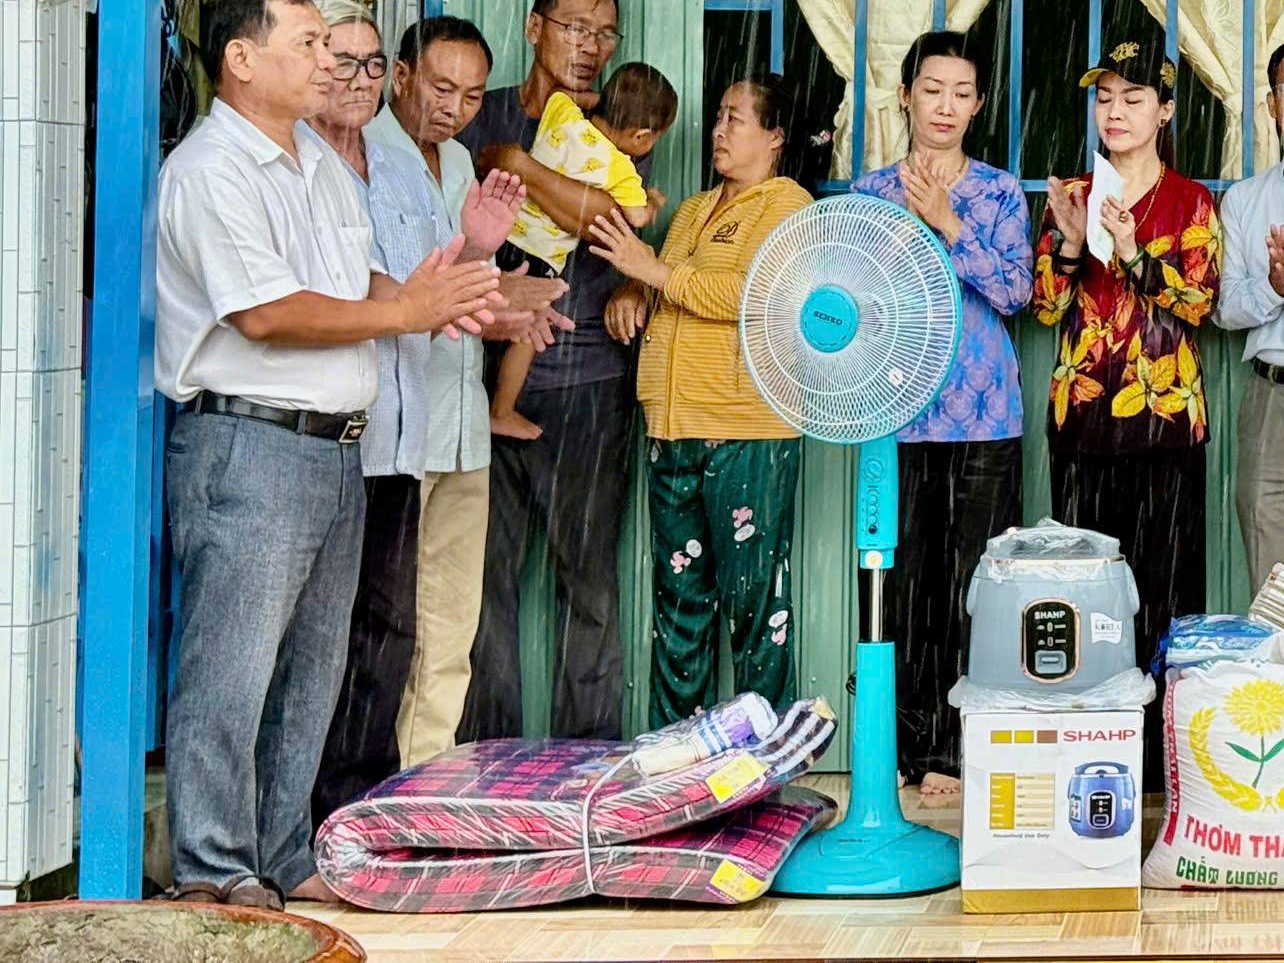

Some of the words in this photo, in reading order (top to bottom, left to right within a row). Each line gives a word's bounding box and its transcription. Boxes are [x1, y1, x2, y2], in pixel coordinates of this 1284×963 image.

[1033, 610, 1066, 620] SHAHP
[1063, 729, 1136, 742] SHAHP
[1184, 813, 1242, 857] THƠM
[1176, 855, 1219, 884] CHẤT
